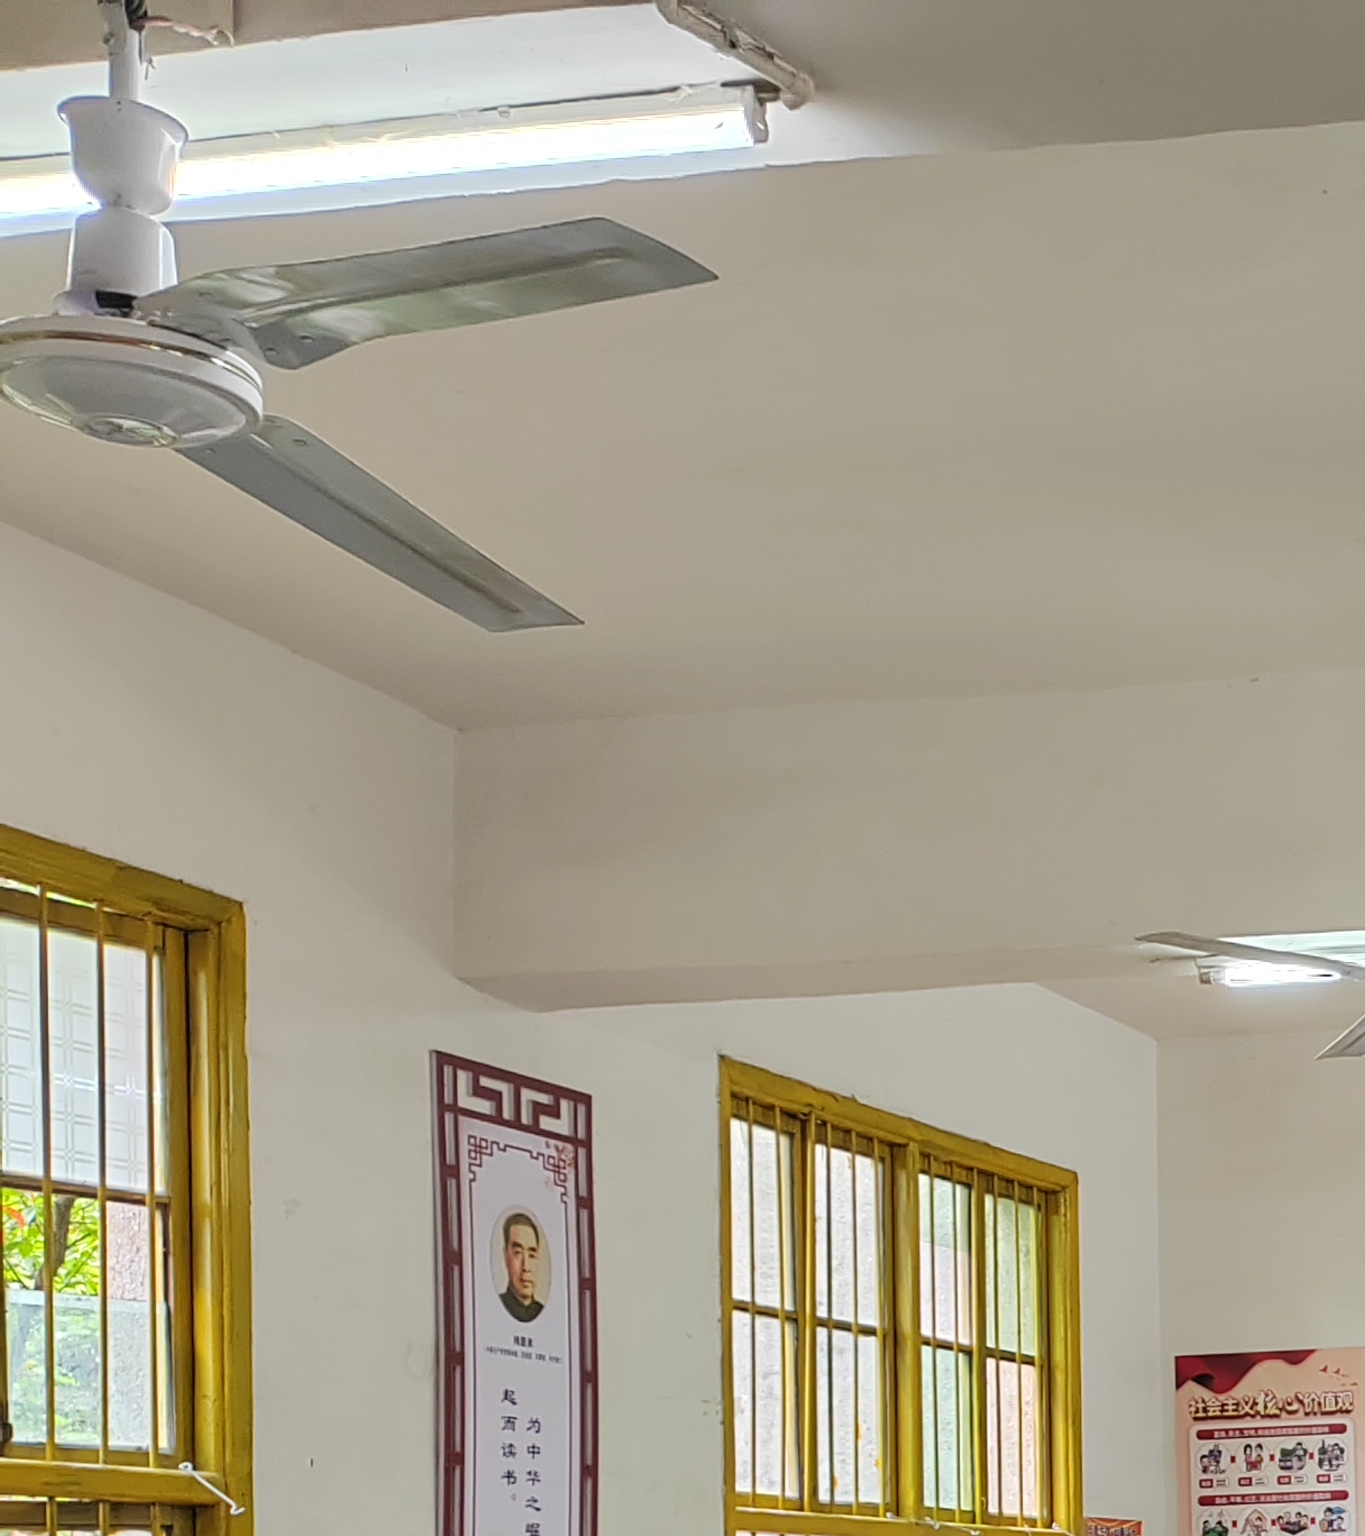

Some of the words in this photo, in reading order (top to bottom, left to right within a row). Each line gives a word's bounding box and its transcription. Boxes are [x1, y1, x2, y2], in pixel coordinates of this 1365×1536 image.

[1188, 1389, 1354, 1419] 社会主义核心价值观
